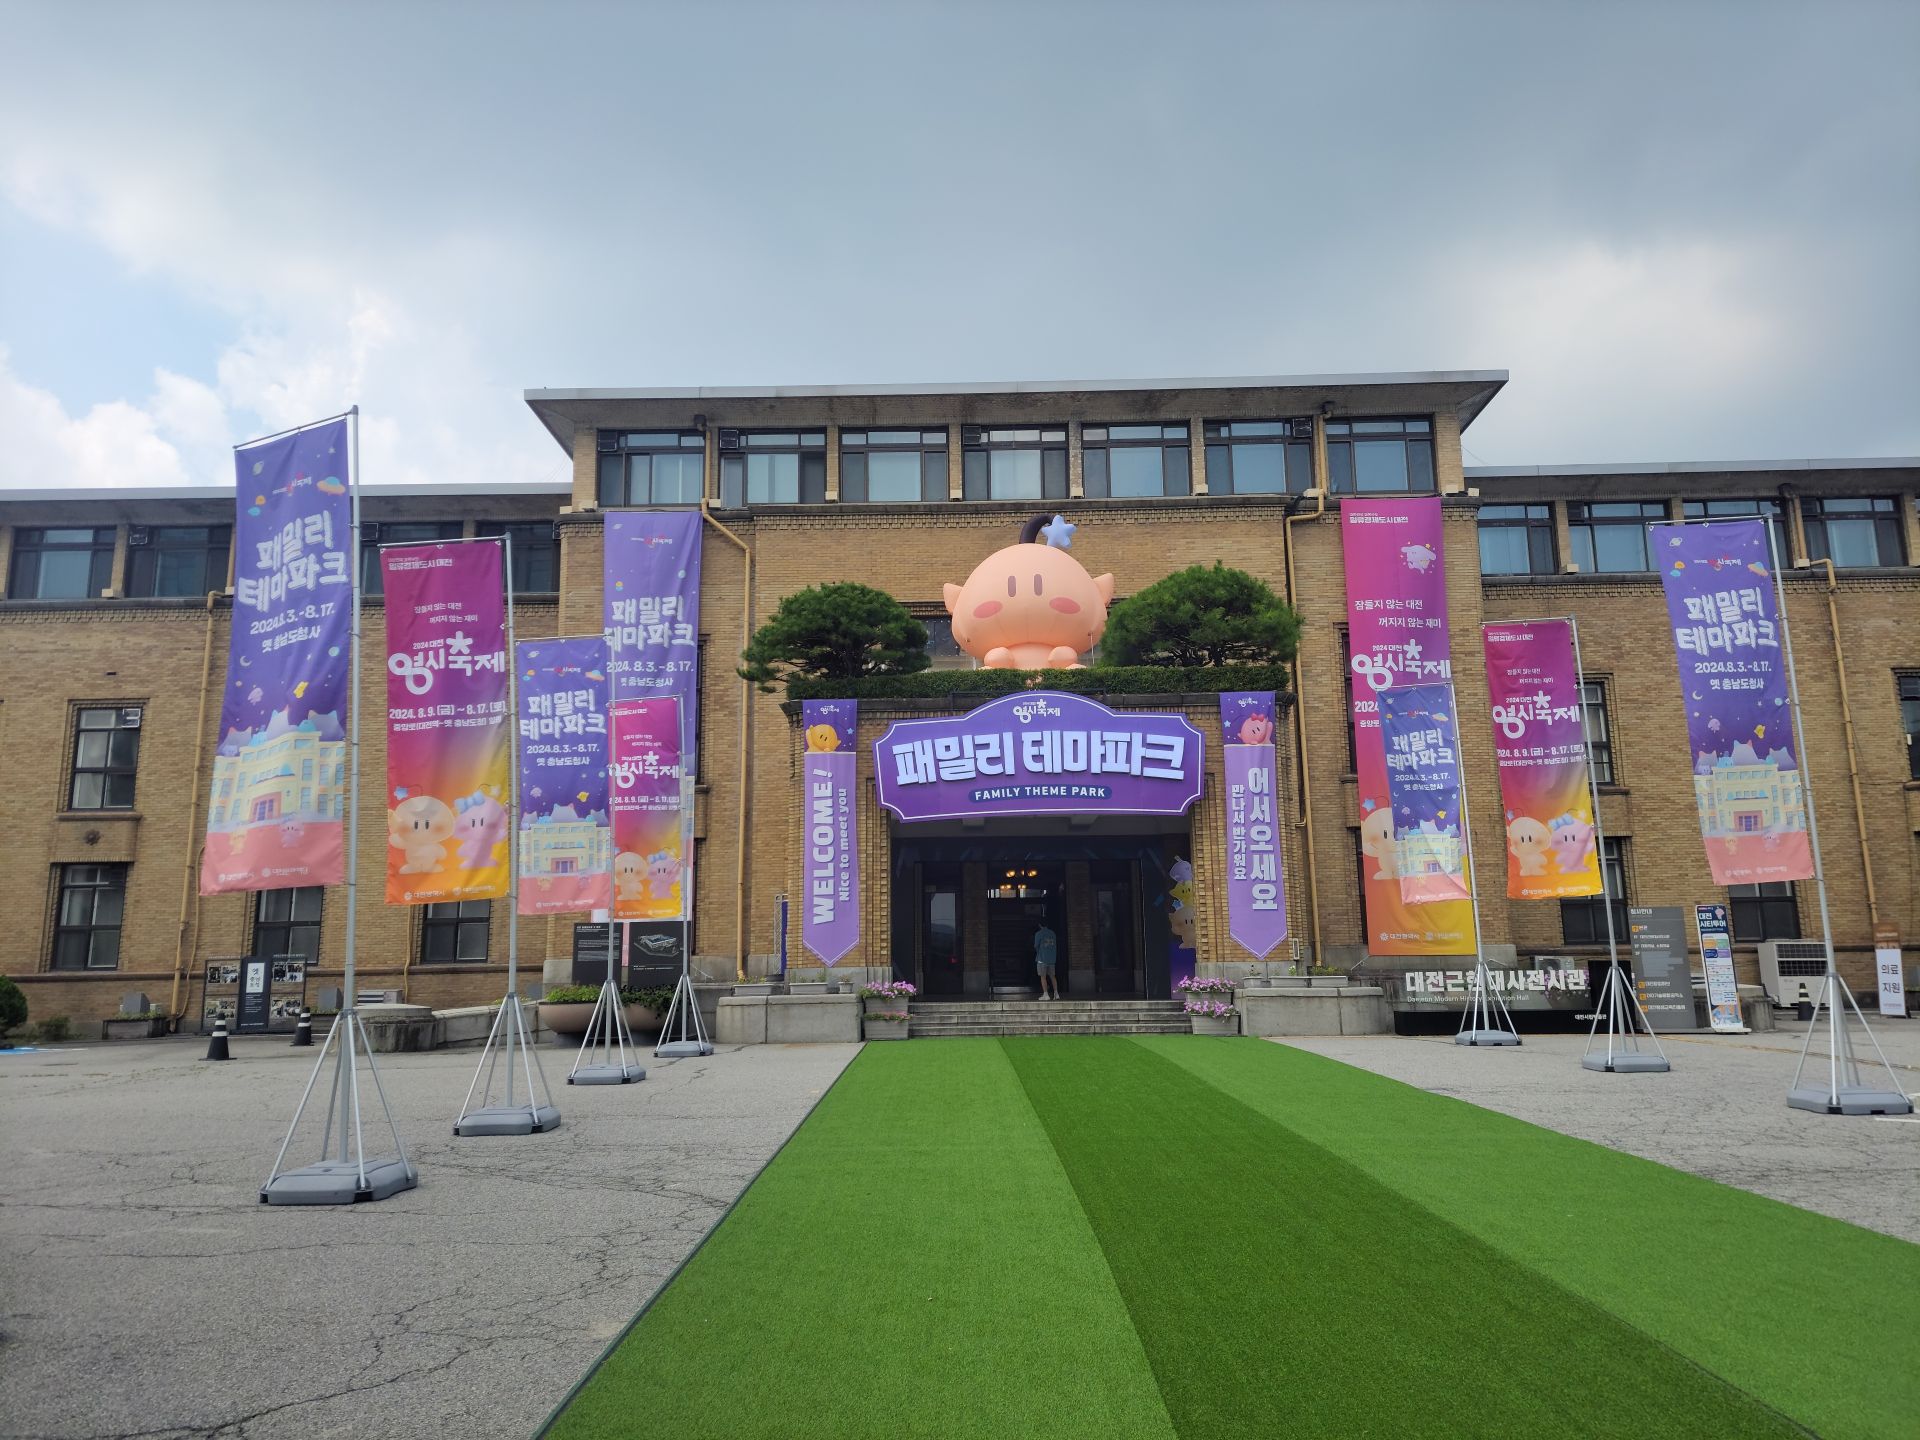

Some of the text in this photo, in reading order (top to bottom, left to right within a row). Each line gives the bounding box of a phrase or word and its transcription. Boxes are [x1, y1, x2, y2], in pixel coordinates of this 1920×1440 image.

[256, 509, 333, 571] 패밀리
[237, 550, 349, 612] 테마파크
[447, 602, 462, 610] 대전
[611, 595, 683, 625] 패밀리
[1354, 599, 1423, 611] 잠들지 않는 대전
[1683, 586, 1764, 625] 패밀리
[1378, 617, 1442, 628] 꺼지지 않는 재미
[429, 638, 444, 648] 대전
[603, 622, 696, 652] 테마파크
[1388, 644, 1403, 652] 대전
[1675, 618, 1779, 657] 테마파크
[1710, 678, 1764, 690] 옛 충남도청사
[527, 688, 596, 717] 패밀리
[520, 712, 608, 741] 테마파크
[1391, 728, 1444, 753] 패밀리
[536, 756, 590, 767] 옛 충남도청사
[891, 729, 1185, 788] 패밀리 테마파크
[1386, 747, 1455, 772] 테마파크
[974, 785, 1106, 801] FAMILY THEME PARK
[839, 788, 850, 902] Nice to meet you
[1231, 784, 1247, 881] 만나서 반가워요
[1247, 767, 1279, 911] 어서오세요
[1698, 912, 1713, 920] 대전
[1881, 964, 1899, 975] 의료
[1882, 982, 1901, 994] 지원
